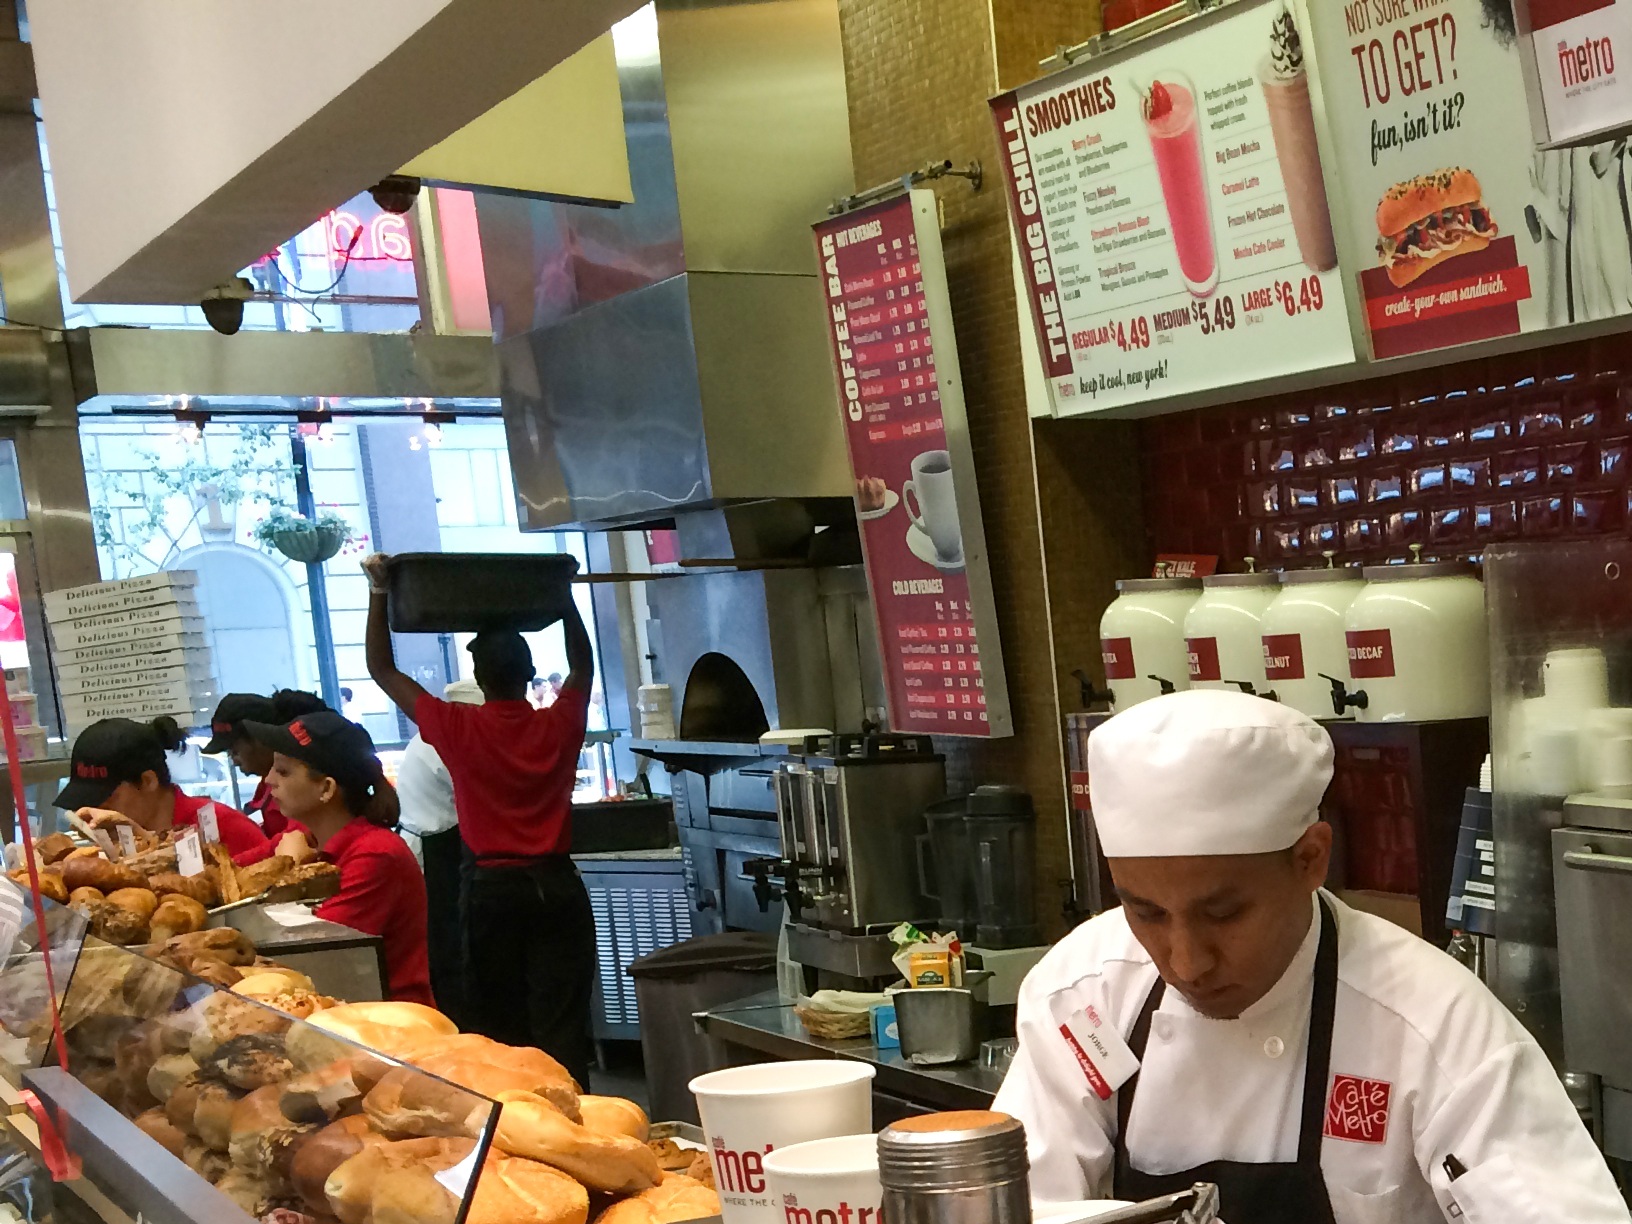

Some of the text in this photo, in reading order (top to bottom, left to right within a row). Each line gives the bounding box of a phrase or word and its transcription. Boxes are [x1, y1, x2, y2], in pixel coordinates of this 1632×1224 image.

[1344, 0, 1371, 36] NOT
[1351, 13, 1458, 108] TO GET?
[1559, 37, 1614, 88] metro
[1025, 75, 1116, 138] SMOOTHIES
[1371, 92, 1465, 166] fun, isn't it?
[1003, 107, 1037, 216] CHILL
[1026, 222, 1053, 285] BIG
[1241, 274, 1324, 316] LARGE $6.49
[1459, 273, 1508, 301] sandwich.
[821, 233, 862, 421] COFFEE BAR
[1040, 290, 1067, 363] THE
[1071, 316, 1151, 352] REGULAR $4.49
[1153, 307, 1191, 332] MEDIUM
[1191, 296, 1236, 335] $5.49
[66, 585, 116, 601] Delicious
[892, 580, 909, 595] COLD
[1357, 646, 1383, 660] DECAF
[1333, 1079, 1386, 1115] Café
[1323, 1099, 1389, 1138] Metro
[750, 1198, 767, 1207] THE
